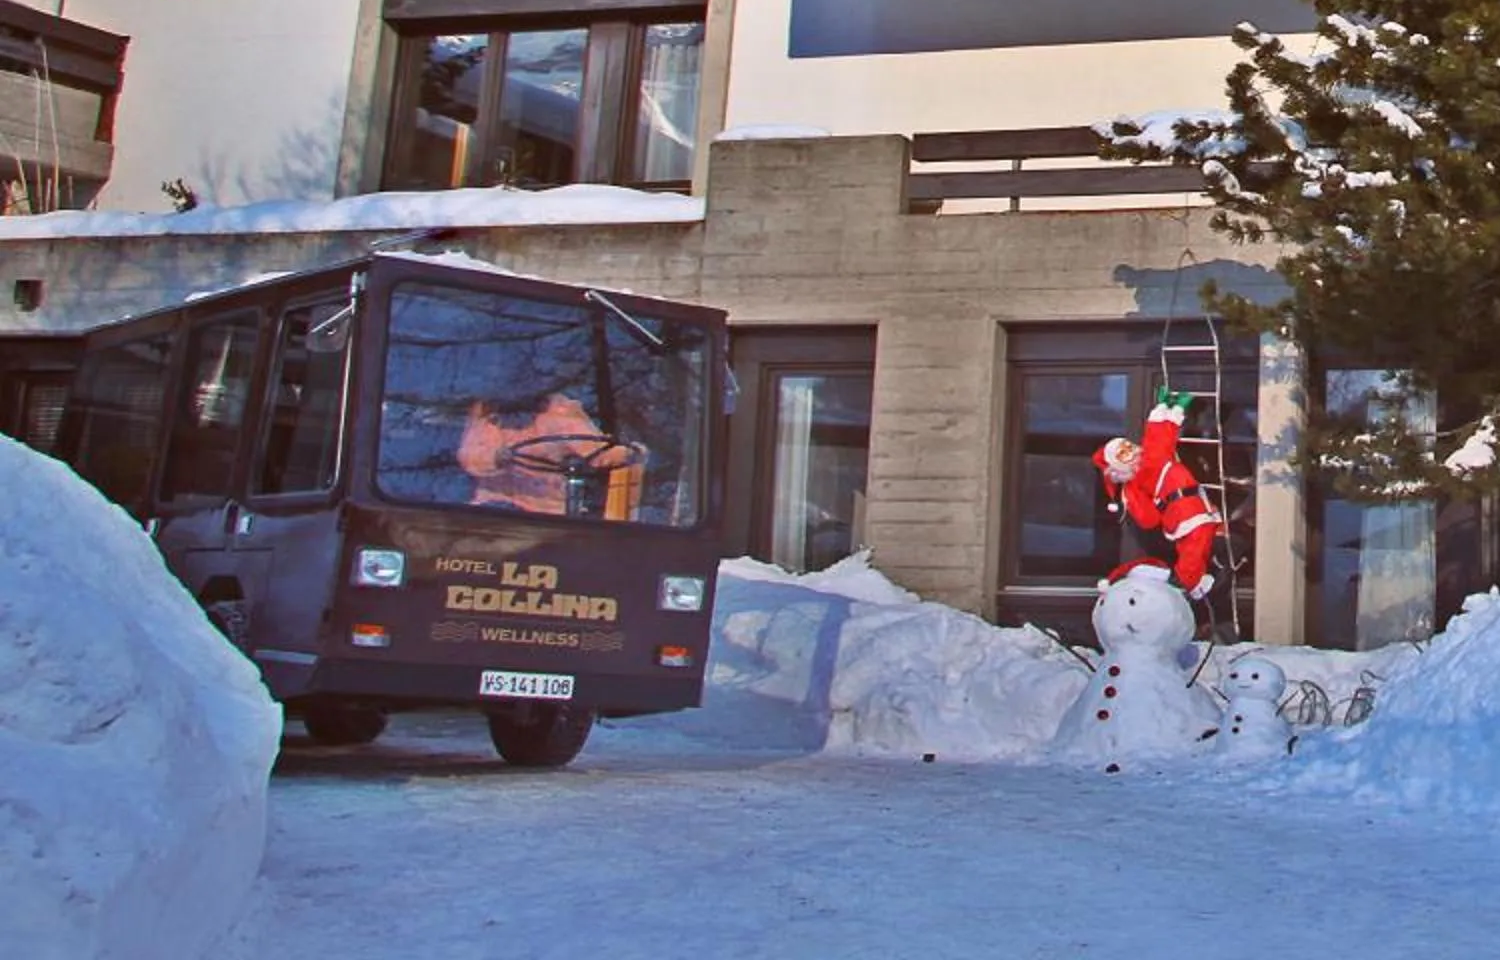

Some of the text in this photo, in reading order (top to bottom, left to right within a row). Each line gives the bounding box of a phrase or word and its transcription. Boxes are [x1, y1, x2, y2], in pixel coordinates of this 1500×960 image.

[436, 557, 558, 589] HOTEL LA
[446, 585, 617, 621] COLLINA
[481, 628, 579, 646] WELLNESS
